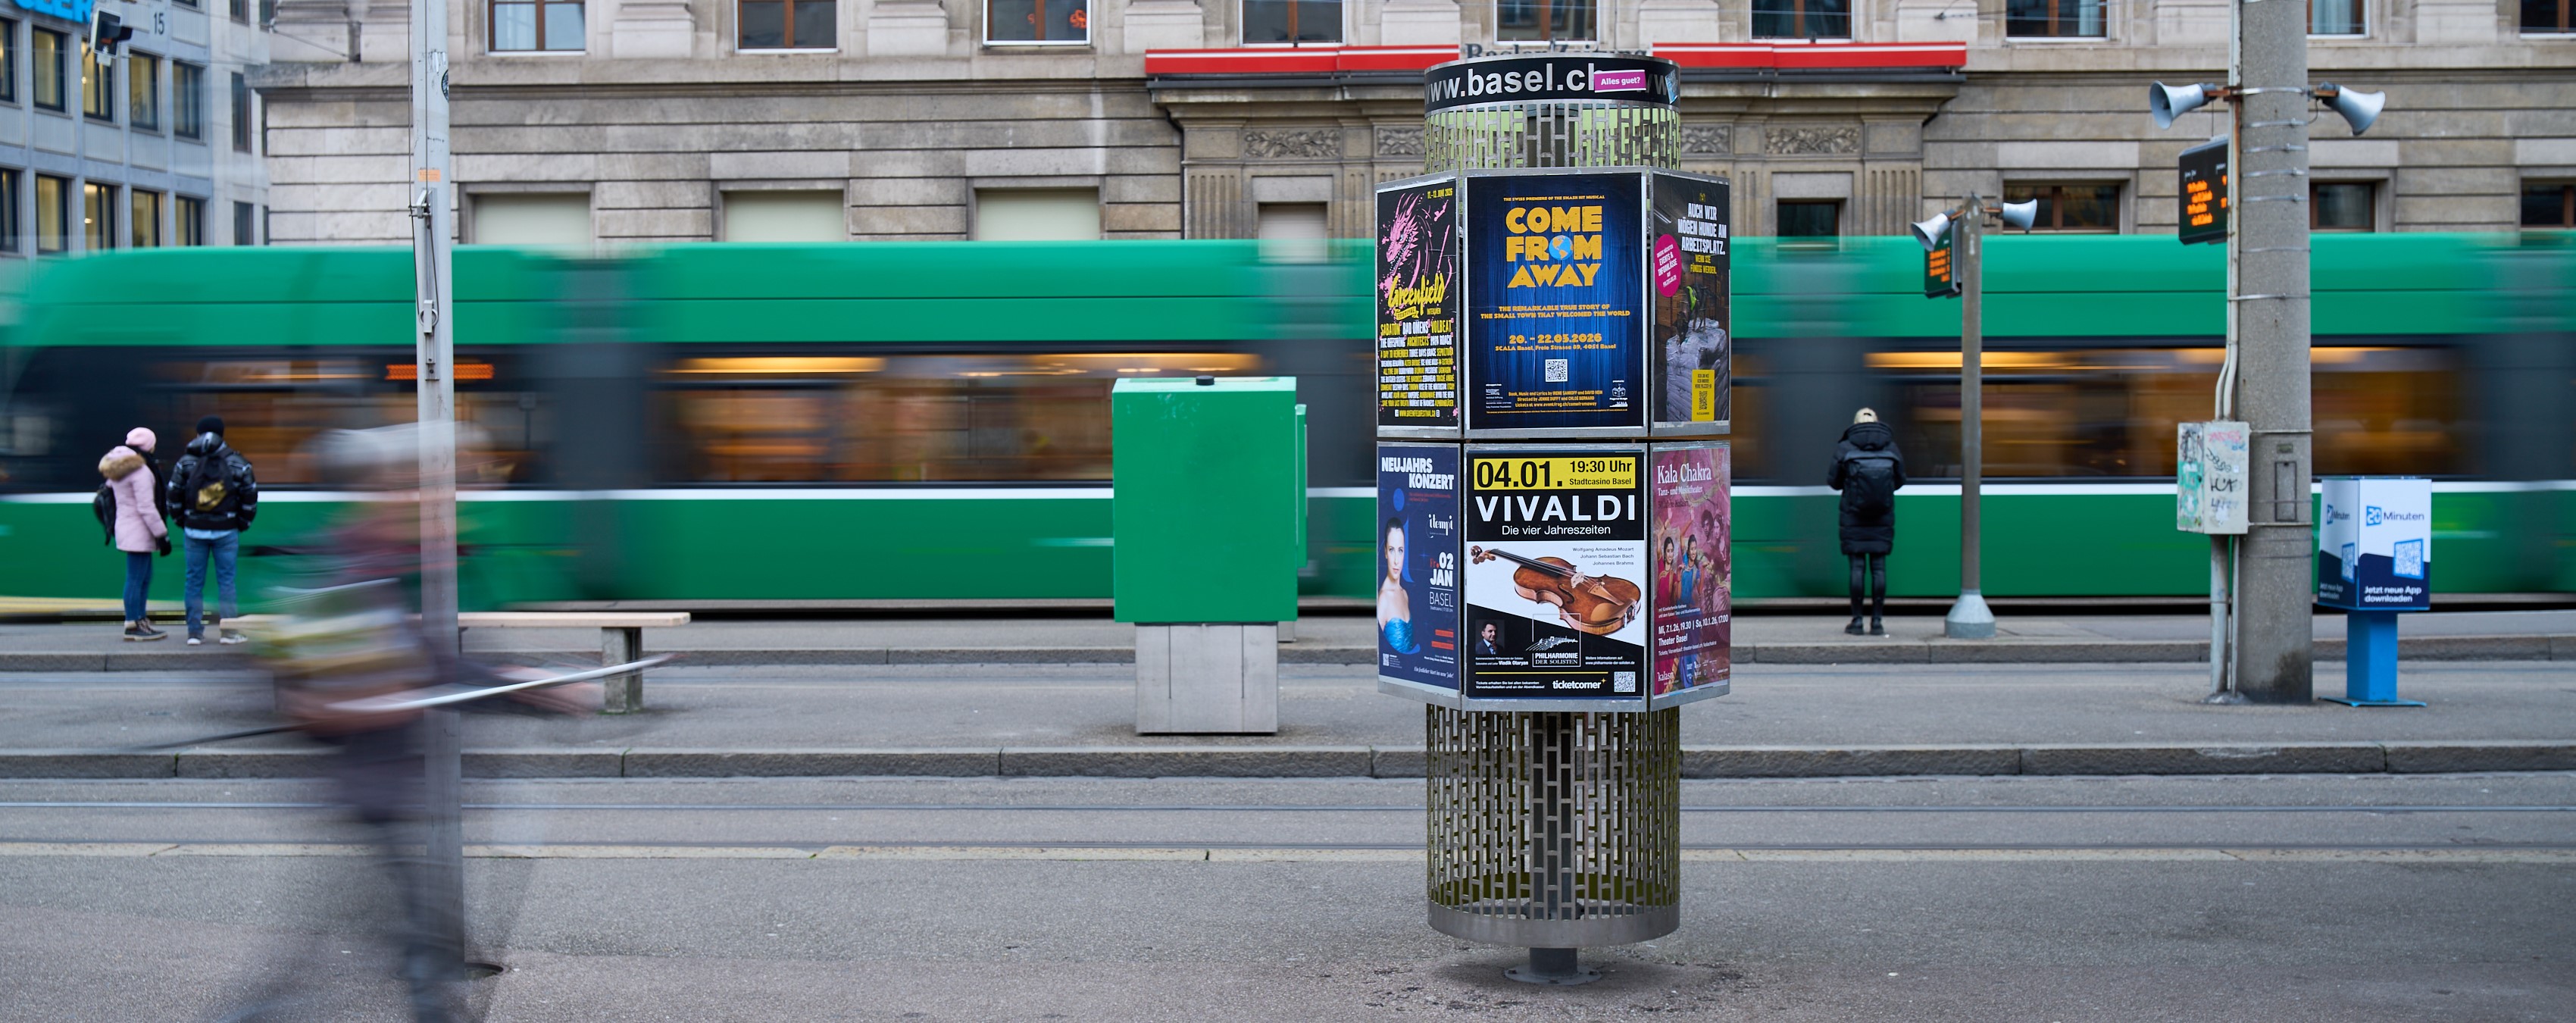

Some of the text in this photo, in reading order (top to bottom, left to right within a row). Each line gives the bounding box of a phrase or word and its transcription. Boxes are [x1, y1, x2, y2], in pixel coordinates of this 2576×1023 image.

[154, 11, 164, 36] 15
[1506, 206, 1602, 233] COME
[1688, 203, 1717, 220] AUCH WIR
[1677, 217, 1727, 238] MÖGEN HUNDE AM
[1506, 235, 1602, 262] FROM
[1682, 236, 1726, 255] ARBEITSPLATZ.
[1508, 264, 1602, 288] AWAY
[1387, 272, 1445, 315] Greenfield
[1397, 308, 1415, 318] FESTIVAL
[1380, 320, 1452, 336] SABATON BAD OMENS VOLBEAT
[1407, 336, 1429, 346] ARCHITECTS
[1509, 335, 1527, 344] 20.
[1382, 458, 1433, 473] NEUJAHRS
[1658, 462, 1712, 483] Kala Chakra
[1409, 473, 1455, 490] KONZERT
[1477, 461, 1632, 488] 04.01. 19:30 Uhr
[1678, 485, 1702, 494] Musiktheater
[1475, 495, 1635, 521] VIVALDI
[2367, 506, 2381, 526] 20
[1502, 526, 1611, 535] Die vier Jahreszeiten
[1440, 552, 1453, 570] 02
[1430, 568, 1453, 587] JAN
[1430, 591, 1453, 607] BASEL
[2365, 586, 2383, 594] Jetzt
[2405, 586, 2422, 596] App
[2365, 594, 2412, 602] downloaden
[1666, 624, 1680, 634] 7.1.26,
[1680, 621, 1691, 630] 19.30
[1702, 617, 1718, 626] 10.1.26,
[1718, 615, 1728, 623] 17.00
[1658, 634, 1688, 646] Theater Basel
[1552, 680, 1601, 690] ticketcorner
